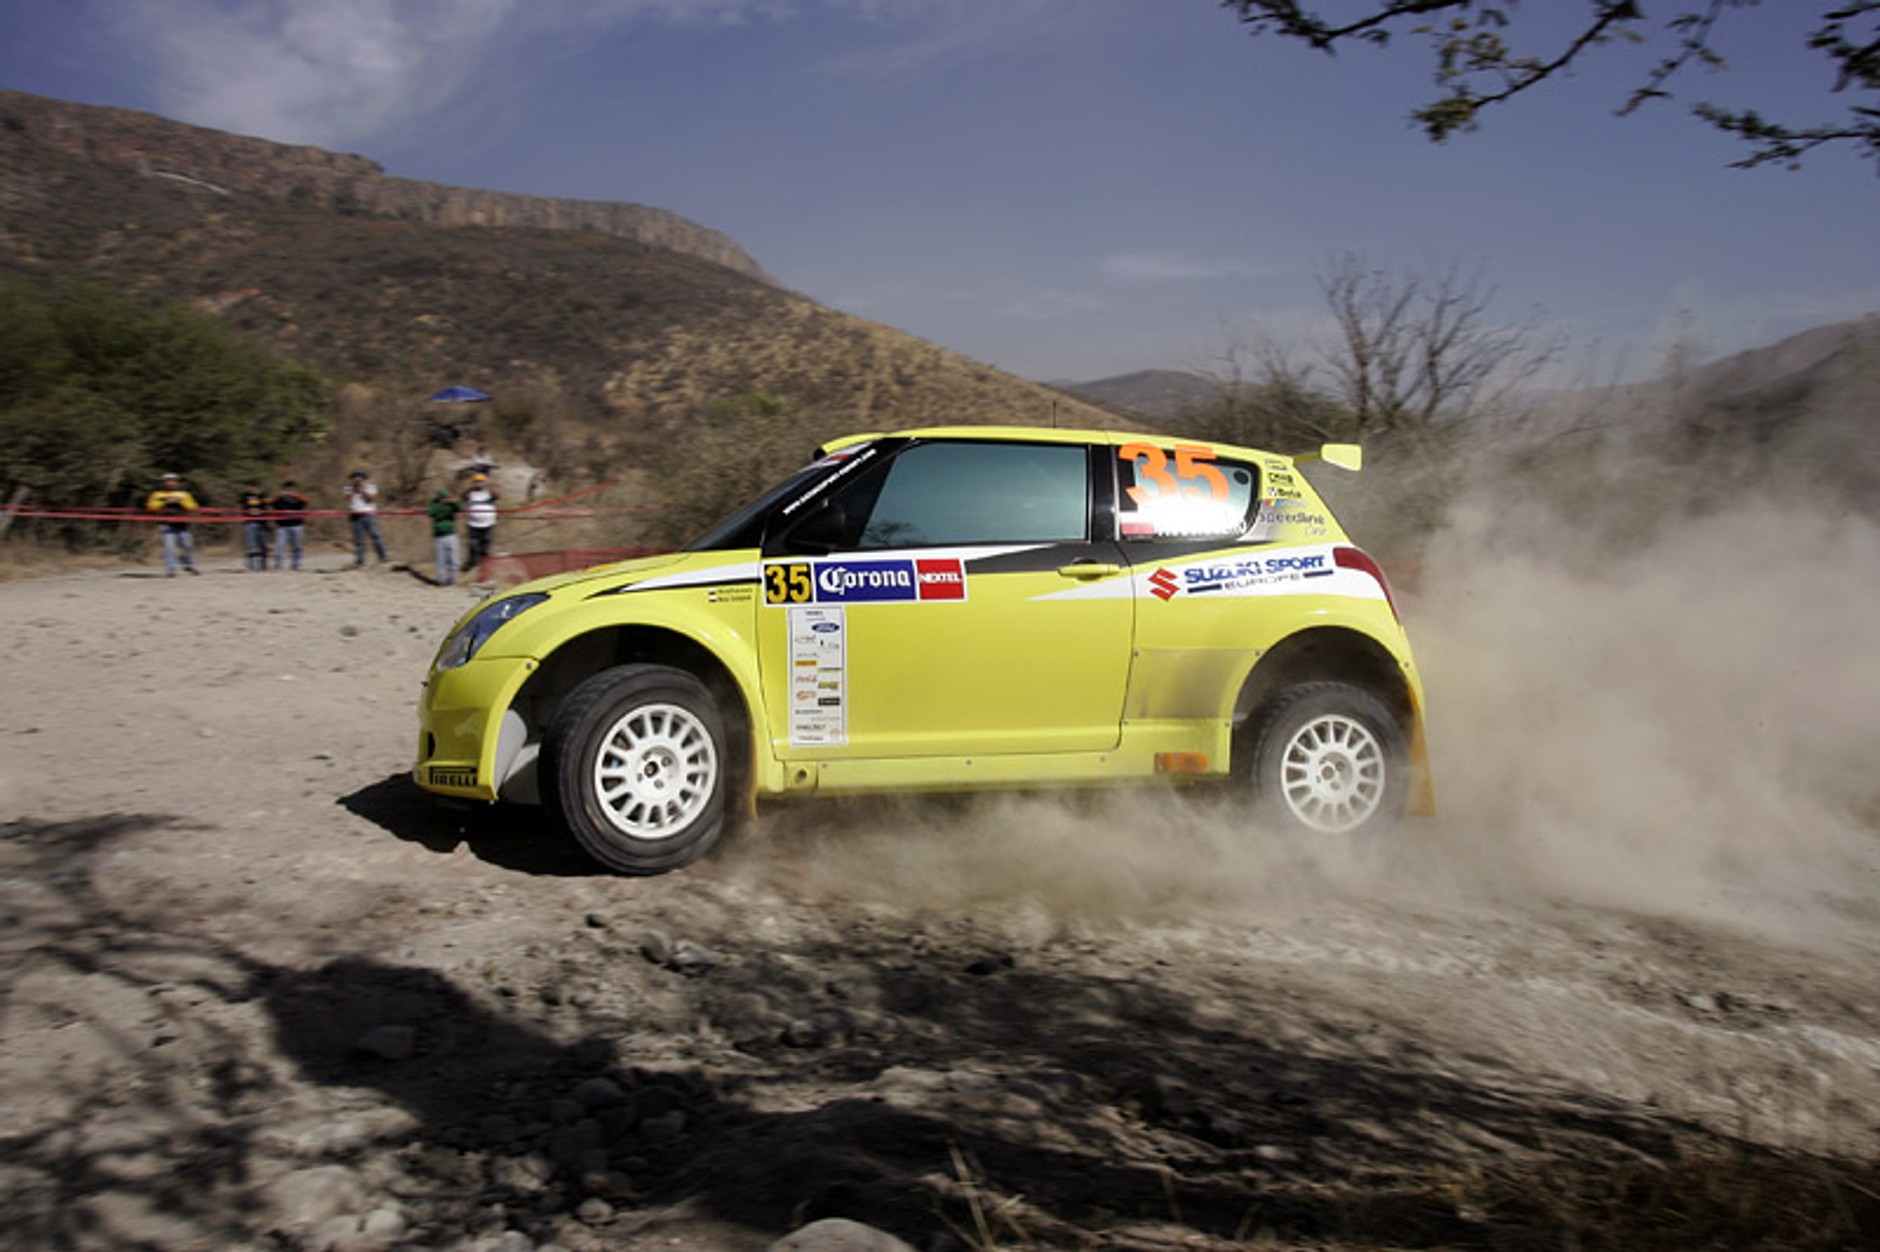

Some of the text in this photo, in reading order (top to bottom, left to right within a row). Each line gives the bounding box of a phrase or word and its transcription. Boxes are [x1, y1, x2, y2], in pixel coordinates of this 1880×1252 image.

[1119, 442, 1230, 503] 35
[765, 564, 963, 603] 35 Corona NEXTEL
[1184, 555, 1325, 585] SUZUKI SPORT
[1224, 573, 1301, 590] EUROPE
[430, 766, 477, 787] PIRELLI
